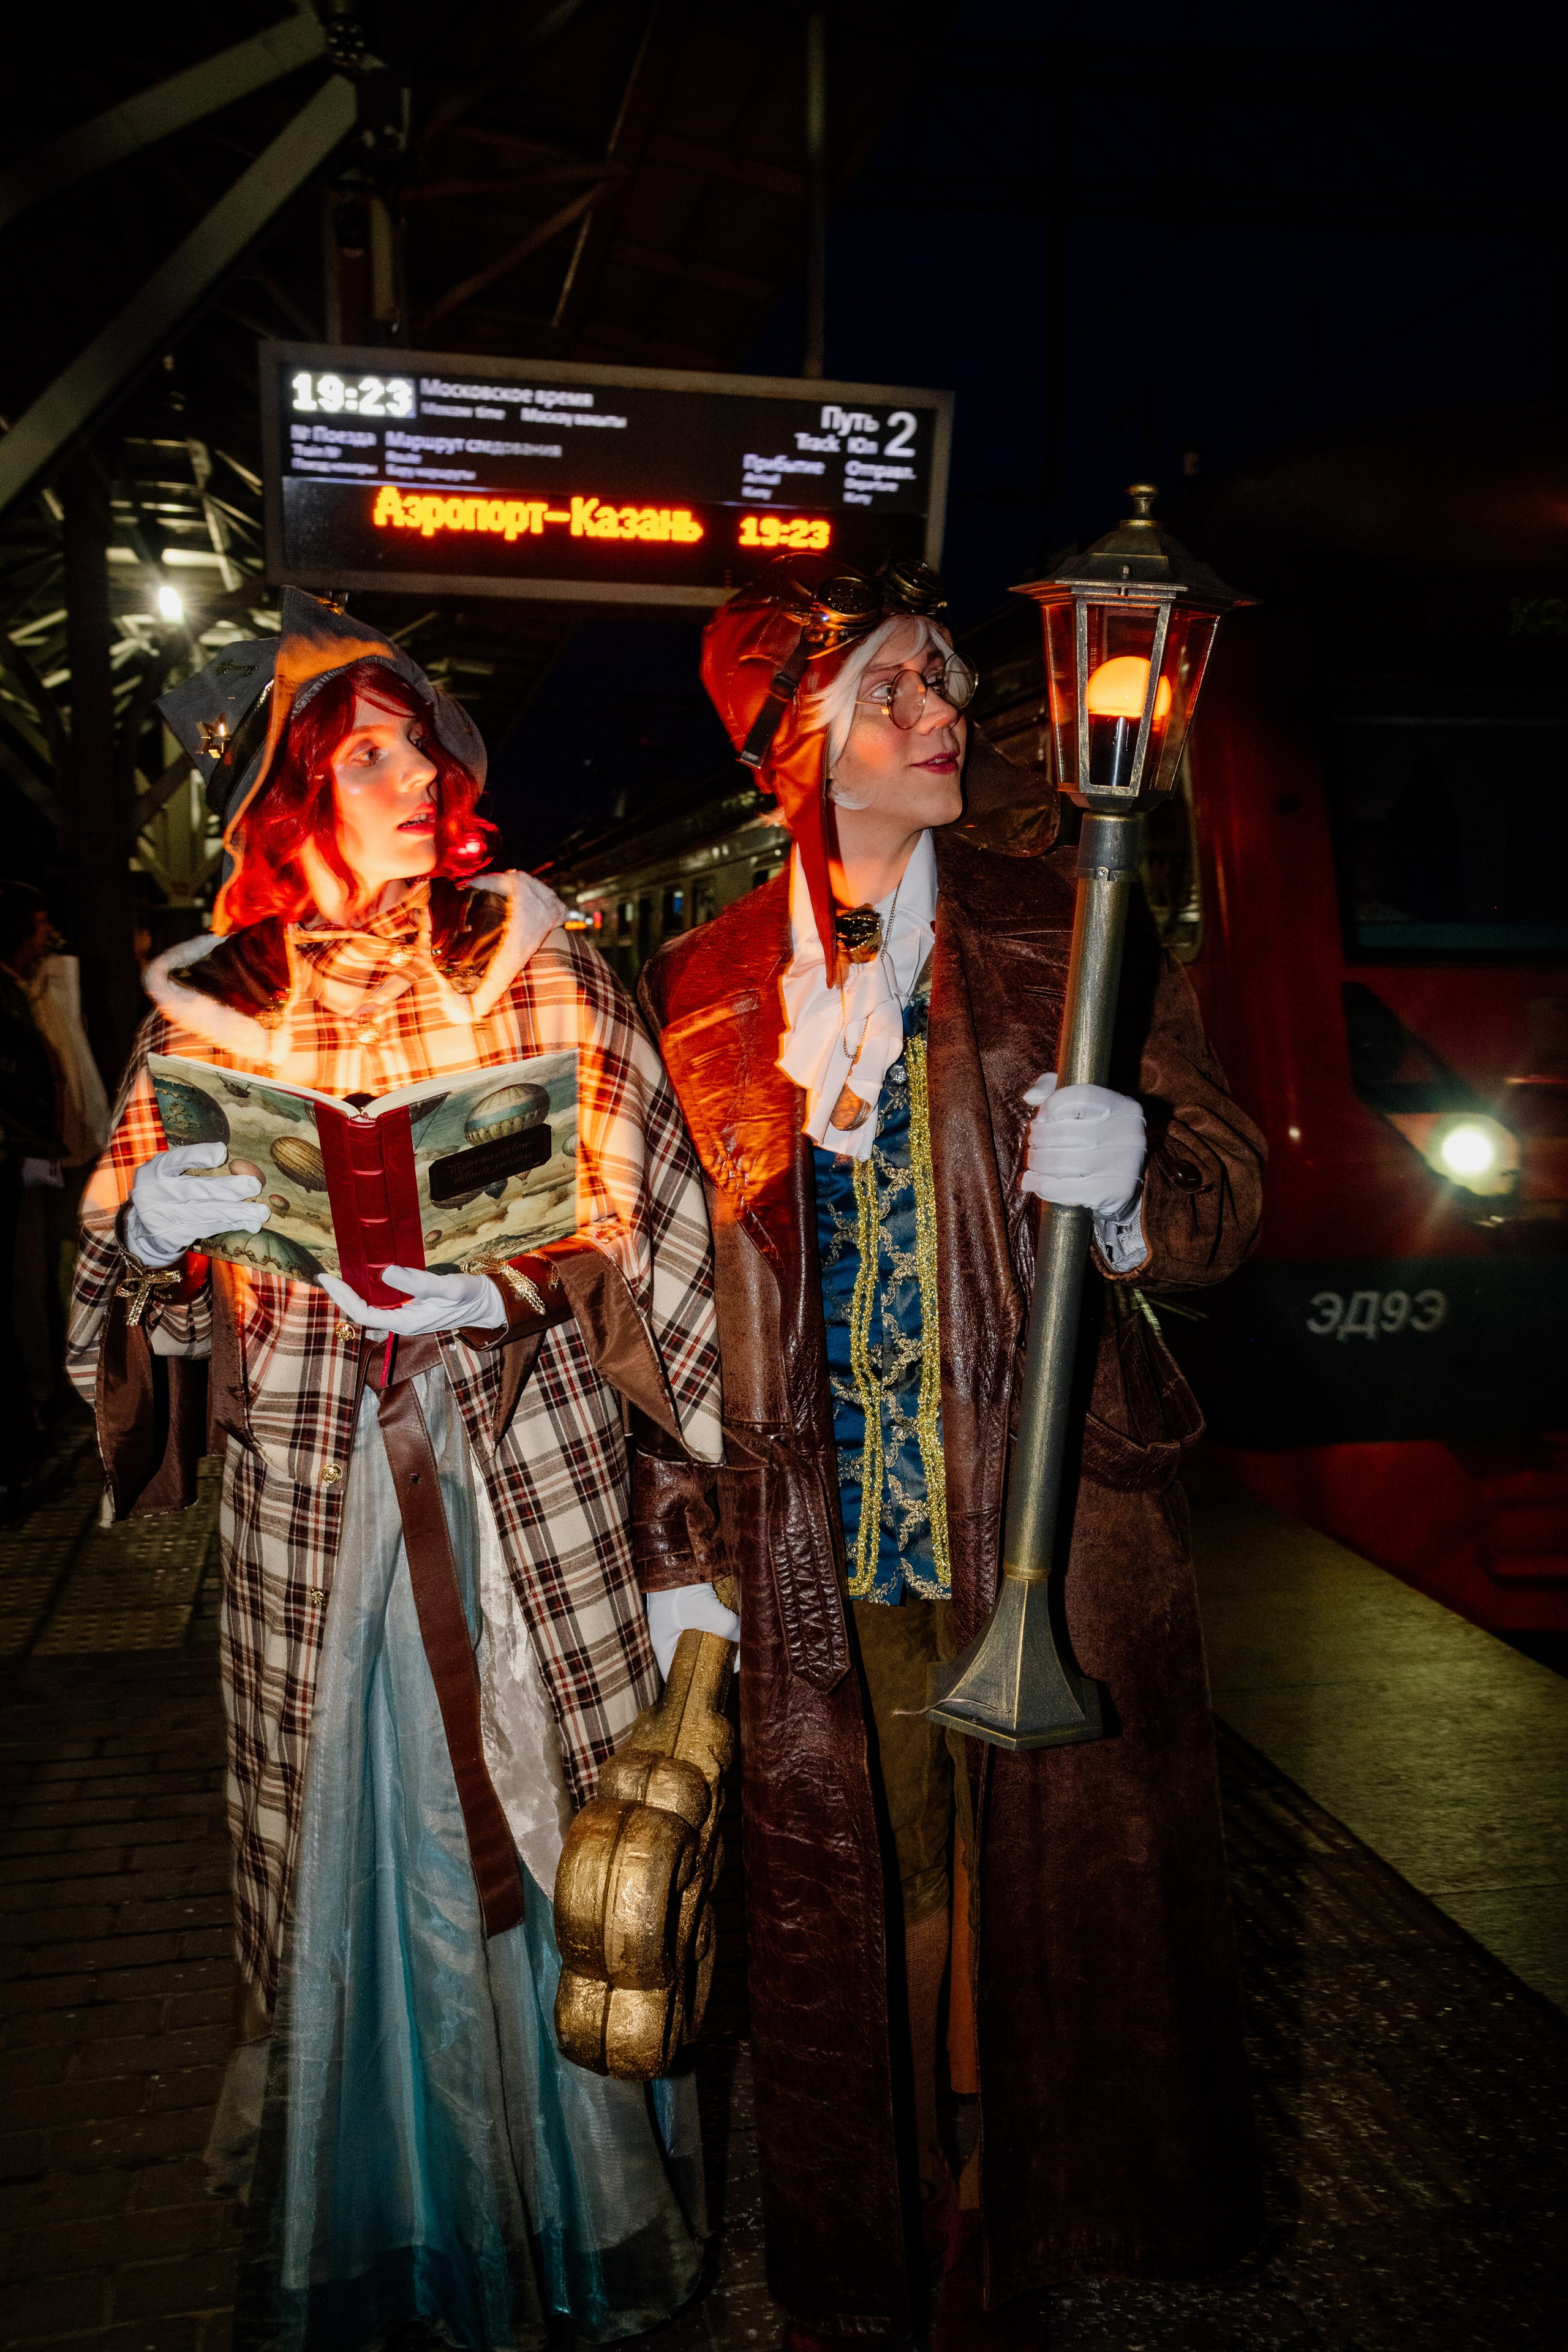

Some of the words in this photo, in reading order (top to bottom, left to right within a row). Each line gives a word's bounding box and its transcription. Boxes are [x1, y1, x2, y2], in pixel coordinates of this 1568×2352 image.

[292, 372, 412, 417] 19:23
[420, 378, 533, 404] Московское
[534, 389, 594, 409] время
[312, 425, 377, 448] Поезда
[385, 431, 465, 455] Маршрут
[465, 439, 563, 458] следования
[794, 432, 841, 452] Track
[821, 405, 880, 436] Путь
[883, 411, 918, 458] 2
[742, 453, 826, 475] Прибытие
[739, 516, 831, 549] 19:23
[1305, 1289, 1448, 1342] ЭД9Э
